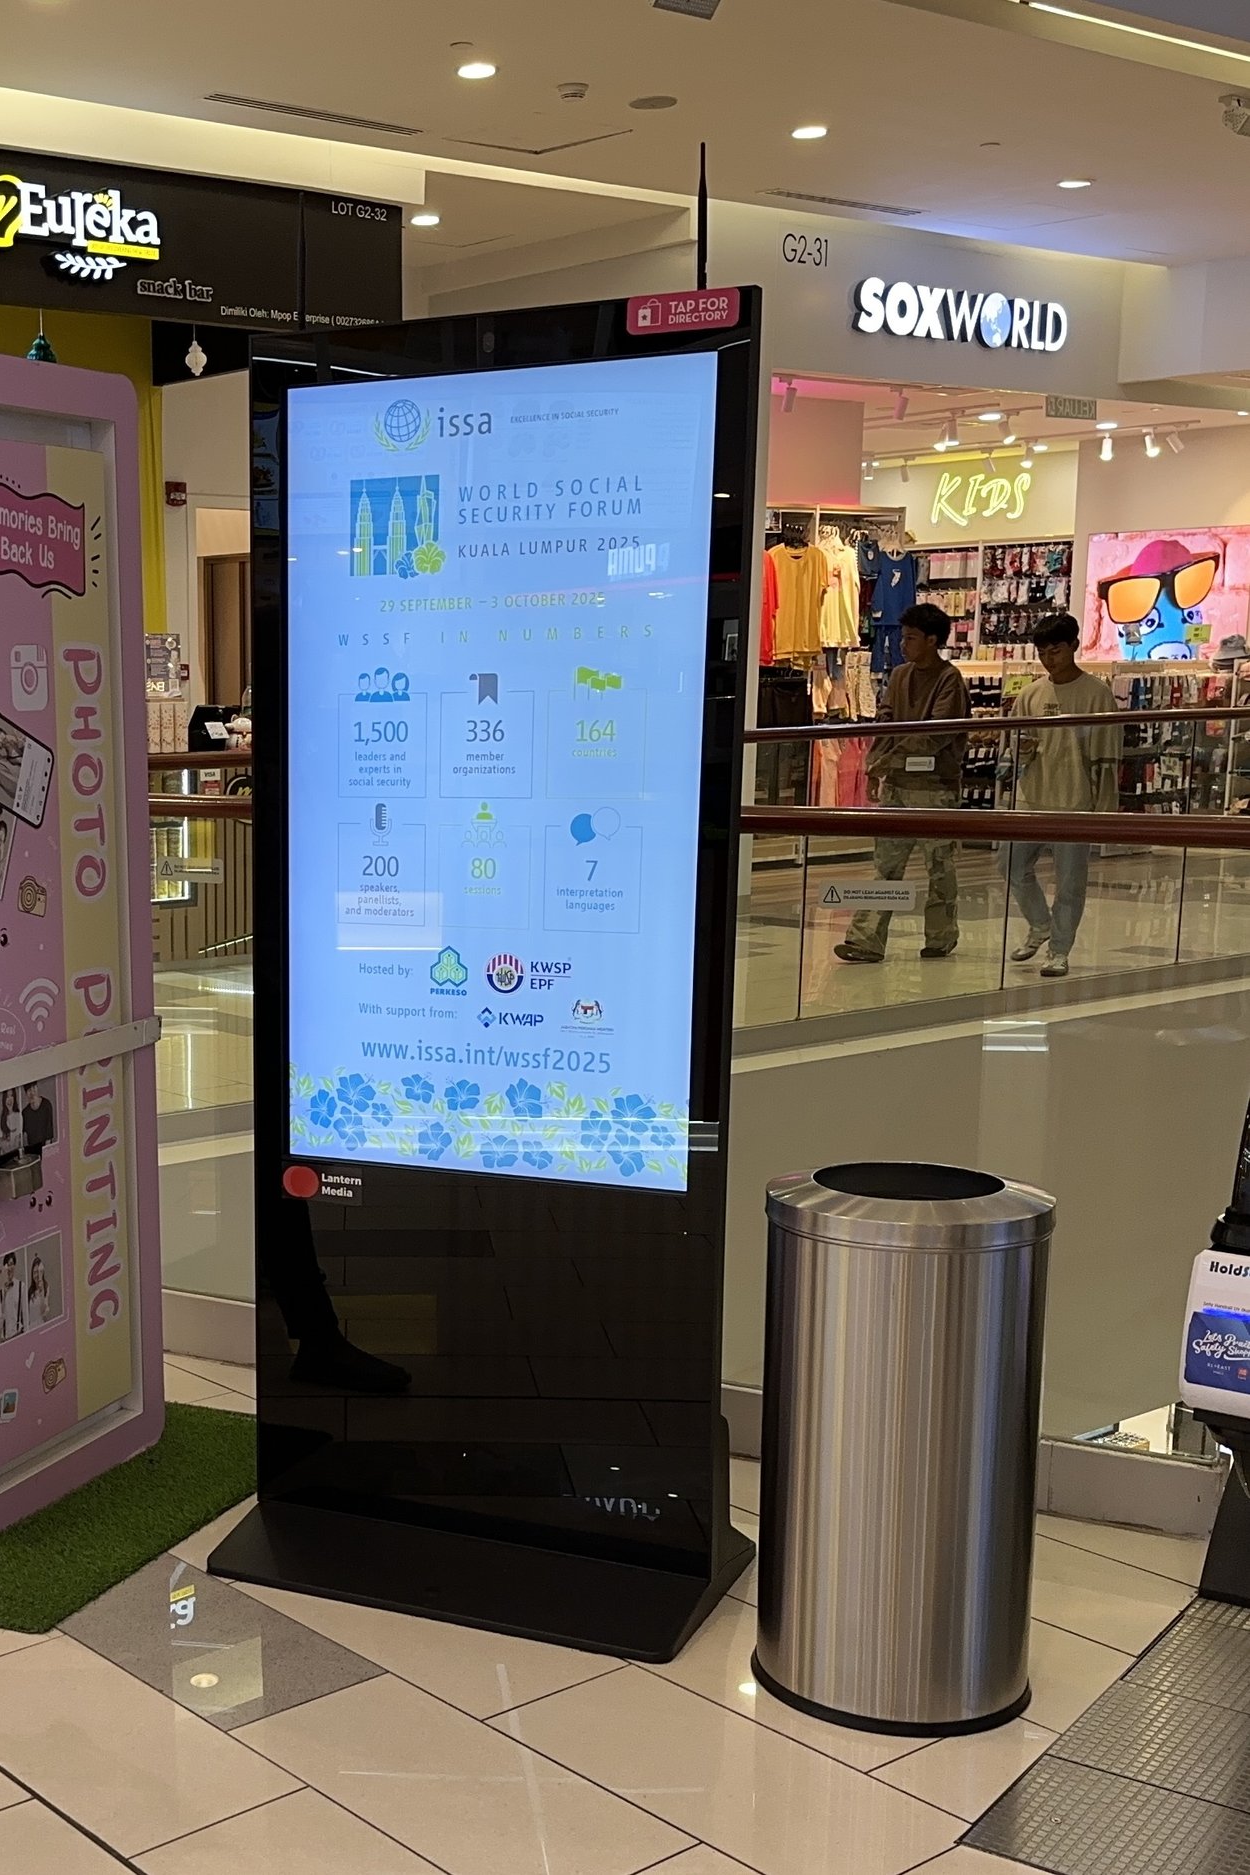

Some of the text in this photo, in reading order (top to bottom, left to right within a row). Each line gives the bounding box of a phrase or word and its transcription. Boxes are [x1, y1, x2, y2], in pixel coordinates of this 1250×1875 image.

[331, 201, 387, 221] LOT G2-32
[782, 233, 829, 267] G2-31
[136, 278, 214, 303] snack bar
[668, 297, 729, 314] TAP FOR
[854, 276, 1068, 352] SOXWORLD
[249, 307, 269, 319] Oleh:
[291, 311, 330, 325] Eerprise
[668, 310, 729, 325] DIRECTORY
[438, 407, 619, 438] issa EXCELLENCE IN SOCIAL SECURITY
[458, 475, 643, 503] WORLD SOCIAL
[931, 473, 1032, 527] KIDS
[458, 498, 642, 525] SECURITY FORUM
[47, 515, 81, 550] Bring
[0, 536, 55, 570] Back Us
[458, 536, 641, 559] KUALA LUMPUR 2025
[380, 599, 395, 613] 29
[400, 596, 472, 612] SEPTEMBER
[491, 596, 499, 609] 3
[504, 593, 569, 608] OCTOBER
[572, 591, 605, 607] 2025
[353, 720, 410, 746] 1,500
[465, 719, 505, 743] 336
[575, 719, 616, 743] 164
[354, 751, 406, 762] leaders and
[466, 751, 504, 762] member
[62, 648, 107, 898] PHOTO
[358, 763, 402, 776] experts in
[453, 763, 516, 777] organizations
[348, 776, 411, 789] social security
[362, 855, 399, 877] 200
[470, 857, 496, 879] 80
[584, 860, 599, 882] 7
[359, 882, 401, 895] speakers,
[463, 885, 502, 896] sessions
[556, 887, 624, 901] interpretation
[344, 905, 415, 918] and moderators
[565, 900, 615, 913] languages
[359, 963, 414, 978] Hosted by:
[530, 961, 572, 974] KWSP
[429, 988, 467, 996] PERKESO
[530, 978, 555, 990] EPF
[359, 1002, 458, 1019] With support from:
[499, 1012, 544, 1027] KWAP
[361, 1040, 611, 1074] www.issa.int/wssf2025
[74, 973, 120, 1332] PINTING
[321, 1173, 362, 1186] Lantern
[321, 1186, 353, 1198] Media
[1192, 1339, 1227, 1359] Safety
